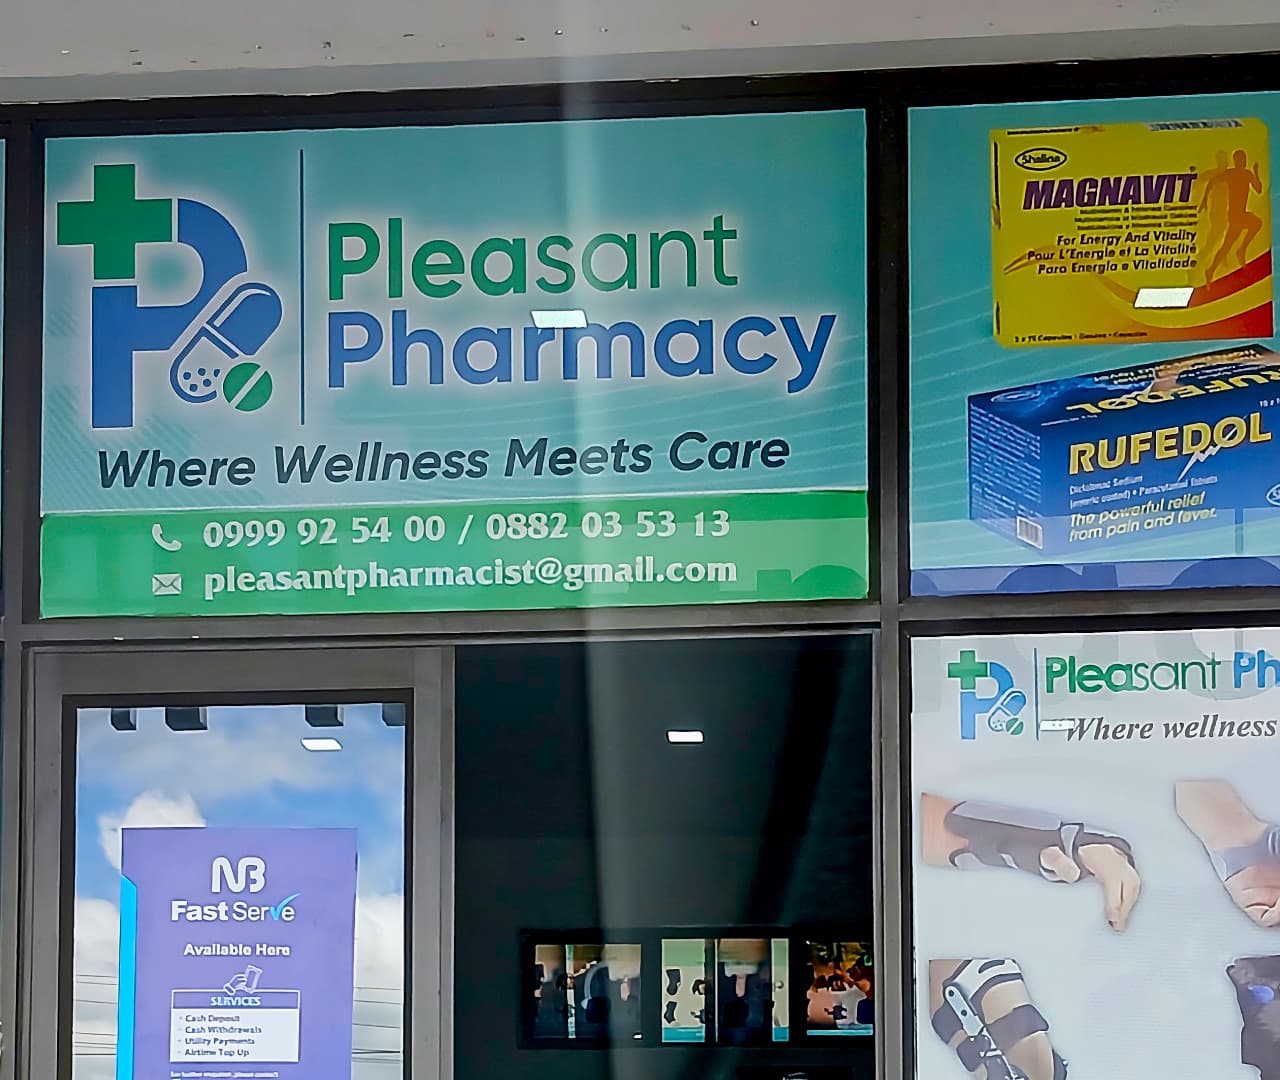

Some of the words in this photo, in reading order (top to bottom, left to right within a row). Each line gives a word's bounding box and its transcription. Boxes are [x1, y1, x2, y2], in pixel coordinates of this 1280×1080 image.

[1022, 172, 1198, 210] MAGNAVIT
[1057, 235, 1077, 247] For
[1080, 233, 1122, 247] Energy
[1124, 231, 1150, 243] And
[1153, 229, 1198, 244] Vitality
[329, 214, 738, 301] Pleasant
[1027, 250, 1055, 261] Pour
[1134, 246, 1149, 256] La
[1038, 264, 1067, 275] Para
[329, 308, 837, 393] Pharmacy
[97, 450, 257, 488] Where
[273, 441, 489, 484] Wellness
[504, 437, 653, 477] Meets
[670, 431, 790, 471] Care
[1071, 513, 1095, 528] The
[1099, 498, 1165, 524] powerful
[1167, 490, 1206, 510] relief
[203, 519, 286, 548] 0999
[297, 518, 337, 545] 92
[351, 517, 392, 543] 54
[404, 515, 445, 542] 00
[486, 512, 569, 540] 0882
[581, 511, 622, 538] 03
[636, 510, 676, 537] 53
[694, 510, 730, 537] 13
[1069, 528, 1103, 543] from
[1106, 519, 1140, 539] pain
[1143, 511, 1174, 530] and
[204, 556, 737, 601] pleasantpharmacist@gmail.com
[1045, 650, 1221, 694] Pleasant
[1163, 714, 1277, 739] wellness
[171, 899, 228, 921] Fast
[231, 895, 298, 921] Serve
[183, 943, 252, 957] Available
[255, 943, 291, 957] Here
[210, 996, 261, 1006] SERVICES
[185, 1014, 207, 1023] Cash
[185, 1025, 206, 1034] Cash
[237, 1048, 250, 1057] Up
